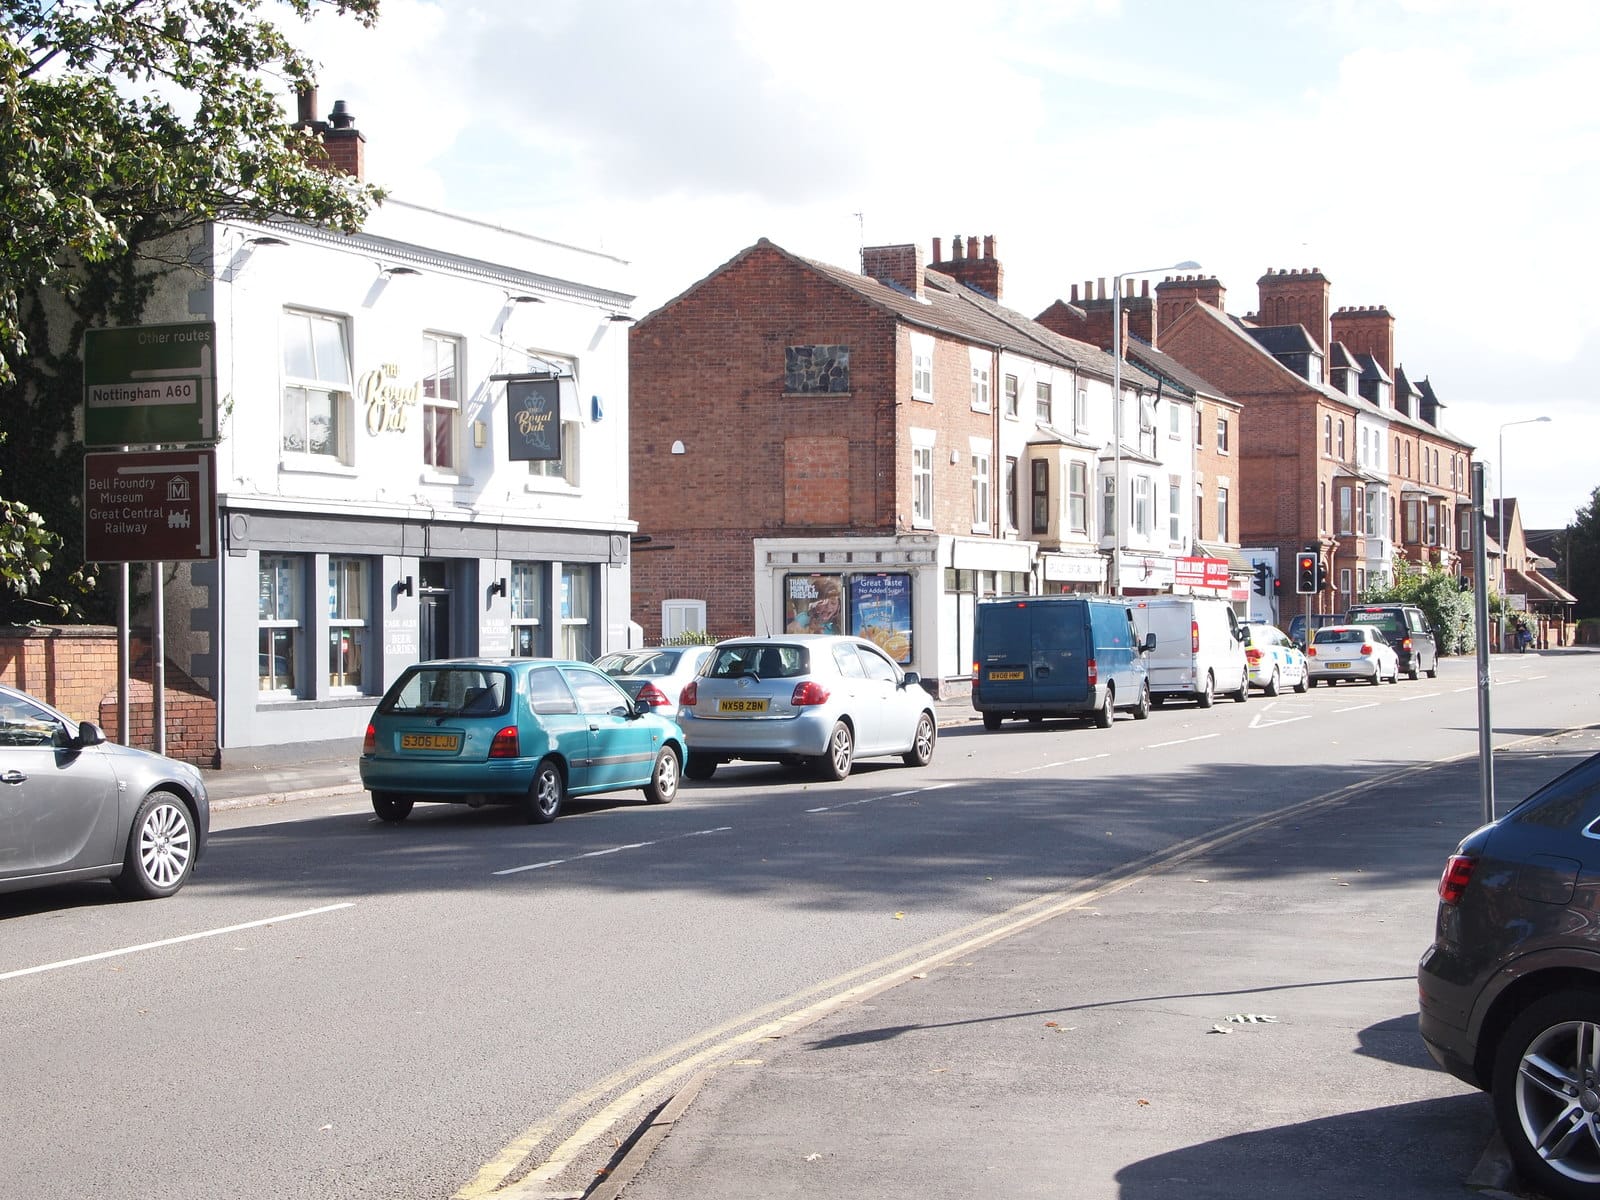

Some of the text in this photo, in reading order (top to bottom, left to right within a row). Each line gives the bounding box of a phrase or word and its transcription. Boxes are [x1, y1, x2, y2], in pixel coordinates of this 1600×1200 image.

[138, 331, 210, 344] Other routes
[93, 385, 191, 402] Nottingham A60
[358, 370, 419, 405] Royal
[515, 411, 552, 424] Royal
[519, 422, 546, 435] Oak
[89, 476, 155, 490] Bell Foundry
[100, 493, 144, 503] Museum
[89, 507, 163, 520] Great Central
[105, 522, 147, 534] Railway
[860, 579, 903, 587] Great Taste
[391, 634, 412, 644] BEER
[385, 644, 417, 655] GARDEN
[722, 701, 763, 711] NX58 ZBN
[403, 735, 432, 747] S306
